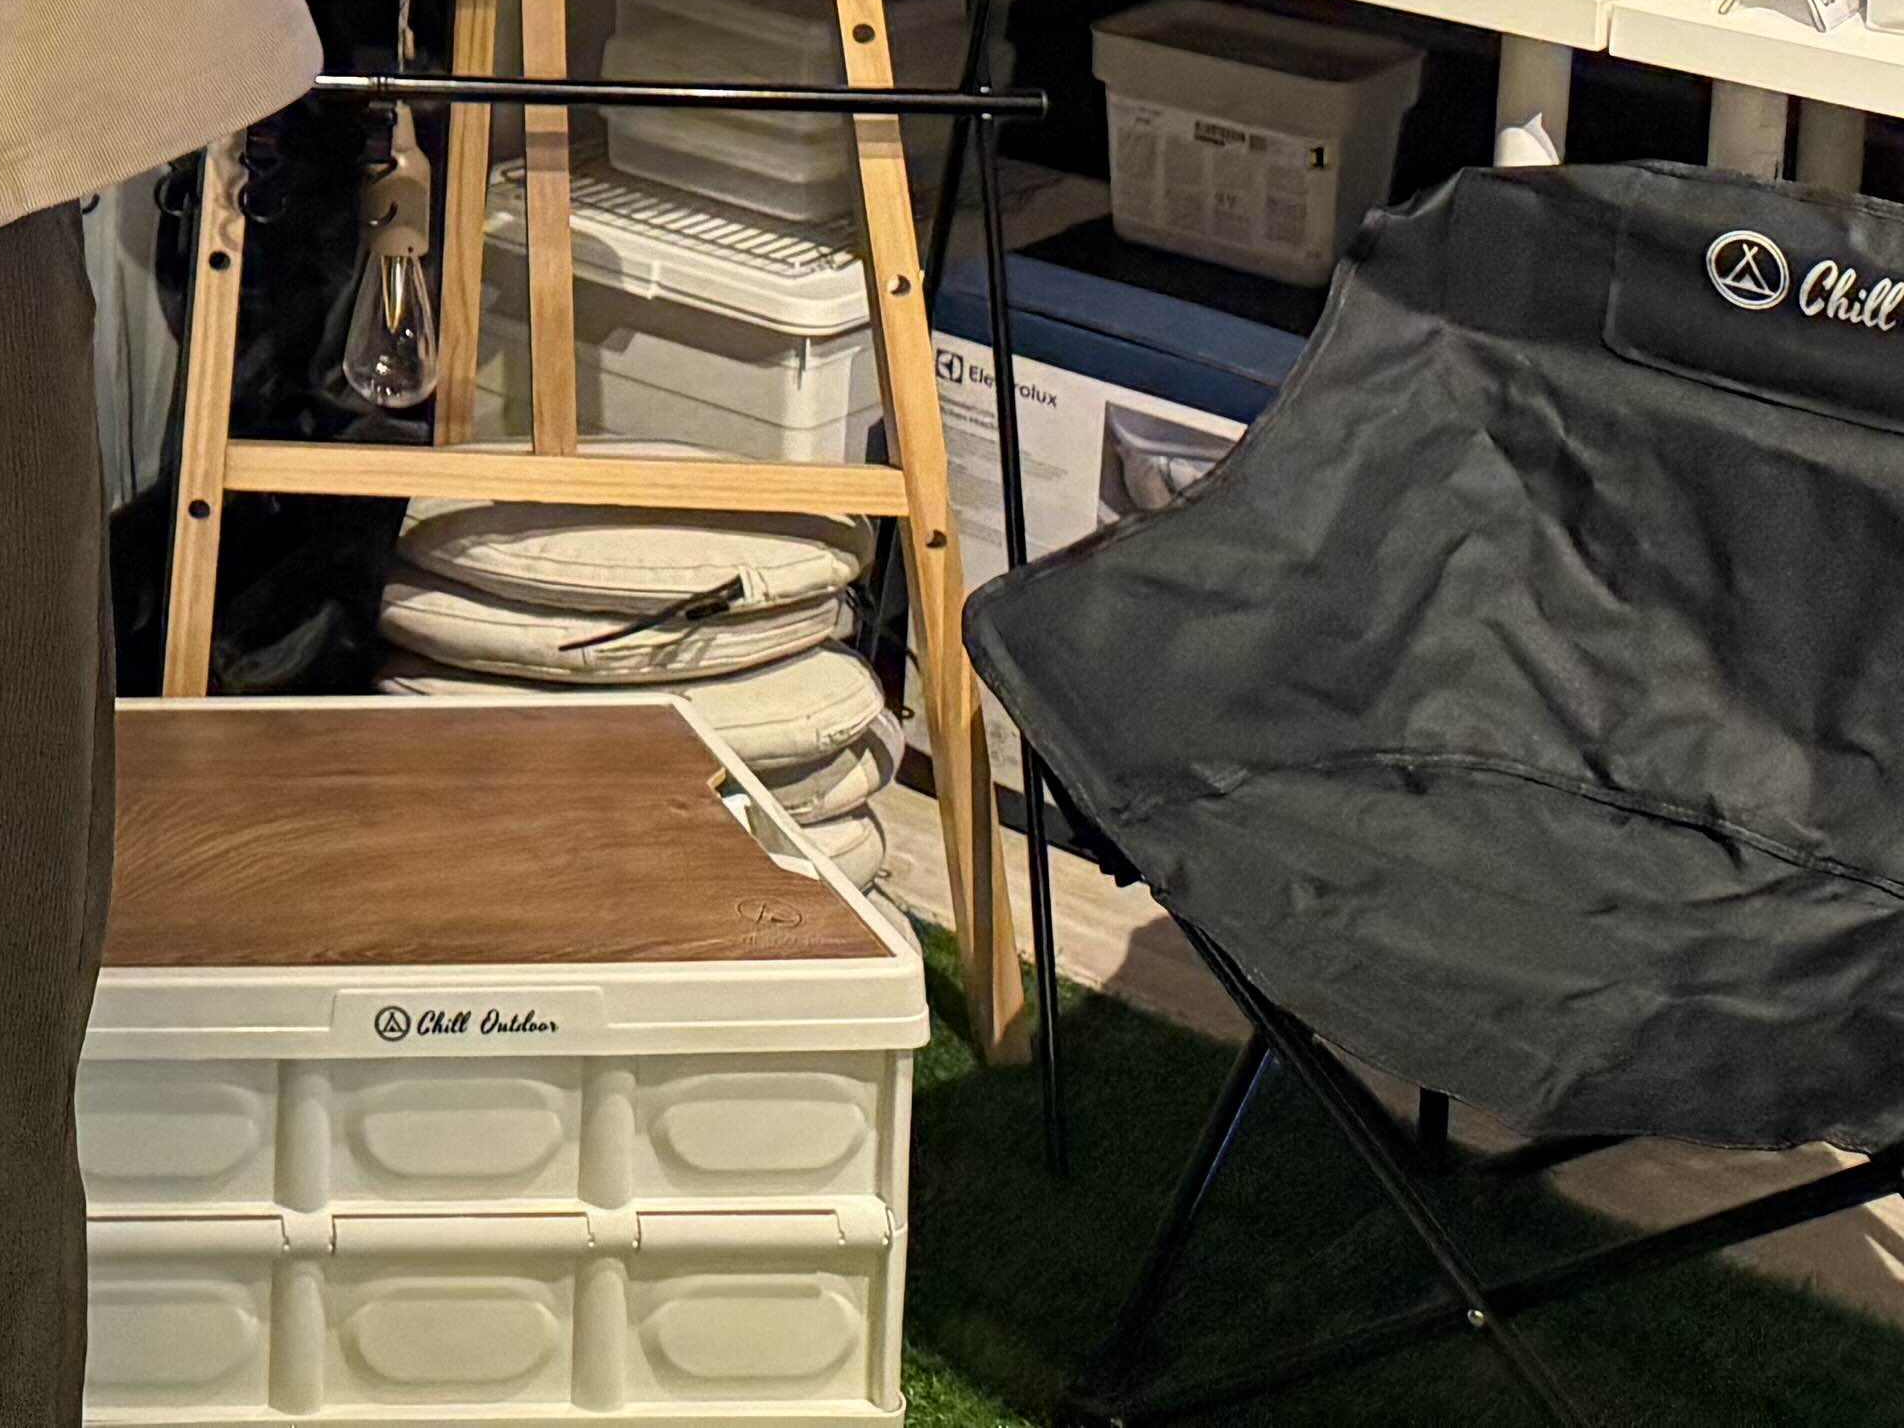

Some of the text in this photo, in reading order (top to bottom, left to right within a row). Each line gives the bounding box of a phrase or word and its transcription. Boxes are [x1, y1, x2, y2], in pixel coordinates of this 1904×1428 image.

[1799, 259, 1904, 332] Chill
[968, 365, 1058, 409] Eleolux
[416, 1007, 559, 1038] Chill Outdoor
